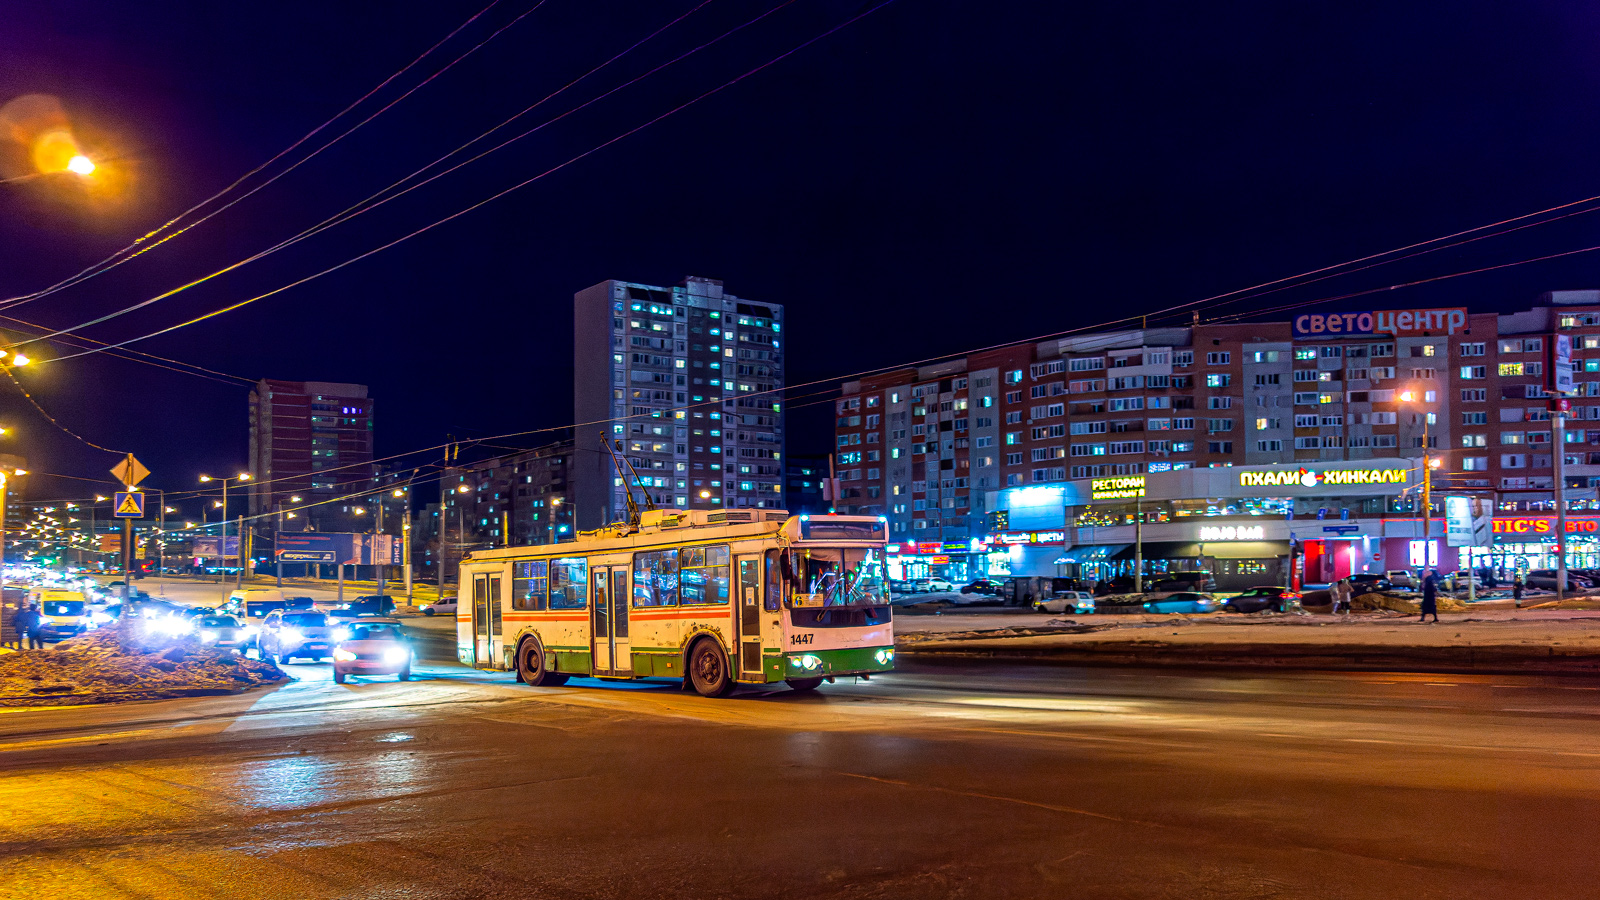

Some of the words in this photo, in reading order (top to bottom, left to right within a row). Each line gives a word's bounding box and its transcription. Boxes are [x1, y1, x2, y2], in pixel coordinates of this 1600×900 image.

[1092, 476, 1145, 490] РЕСТОРАН
[1240, 471, 1300, 486] ПХАЛИ
[1323, 469, 1407, 484] ХИНКАЛИ
[1237, 525, 1264, 540] BAR
[1492, 520, 1550, 533] TIC'S
[1564, 521, 1598, 532] ВТО
[790, 633, 814, 645] 1447
